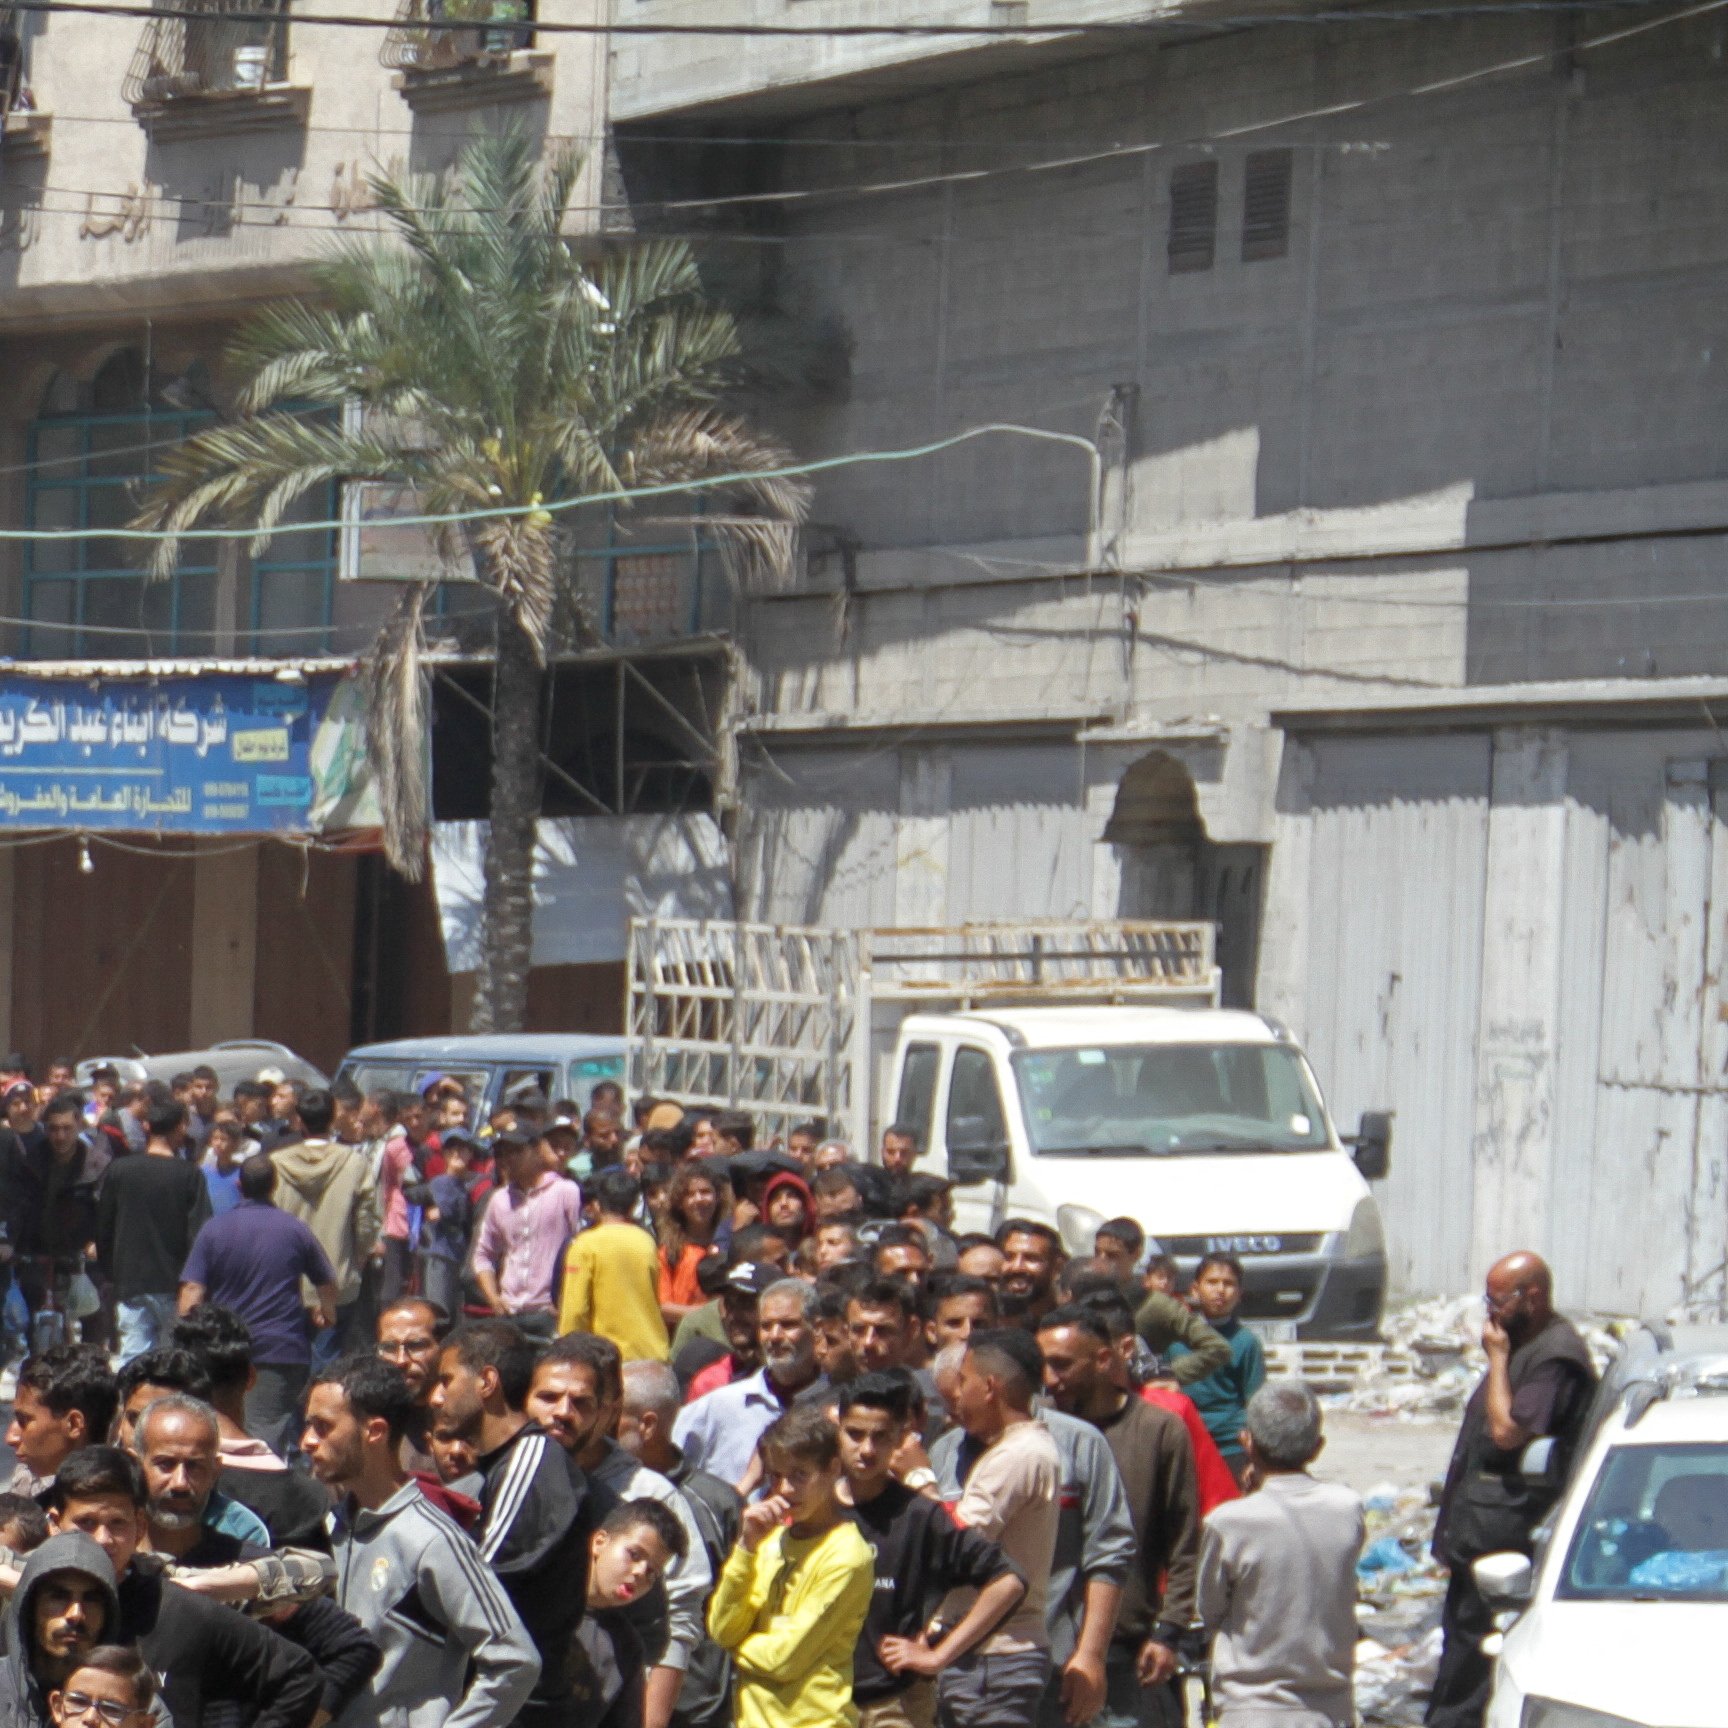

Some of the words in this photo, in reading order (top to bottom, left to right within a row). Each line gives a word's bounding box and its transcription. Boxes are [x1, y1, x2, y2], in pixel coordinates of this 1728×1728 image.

[70, 706, 108, 757] عبد
[158, 693, 227, 757] شركة
[1205, 1237, 1282, 1253] IVECO
